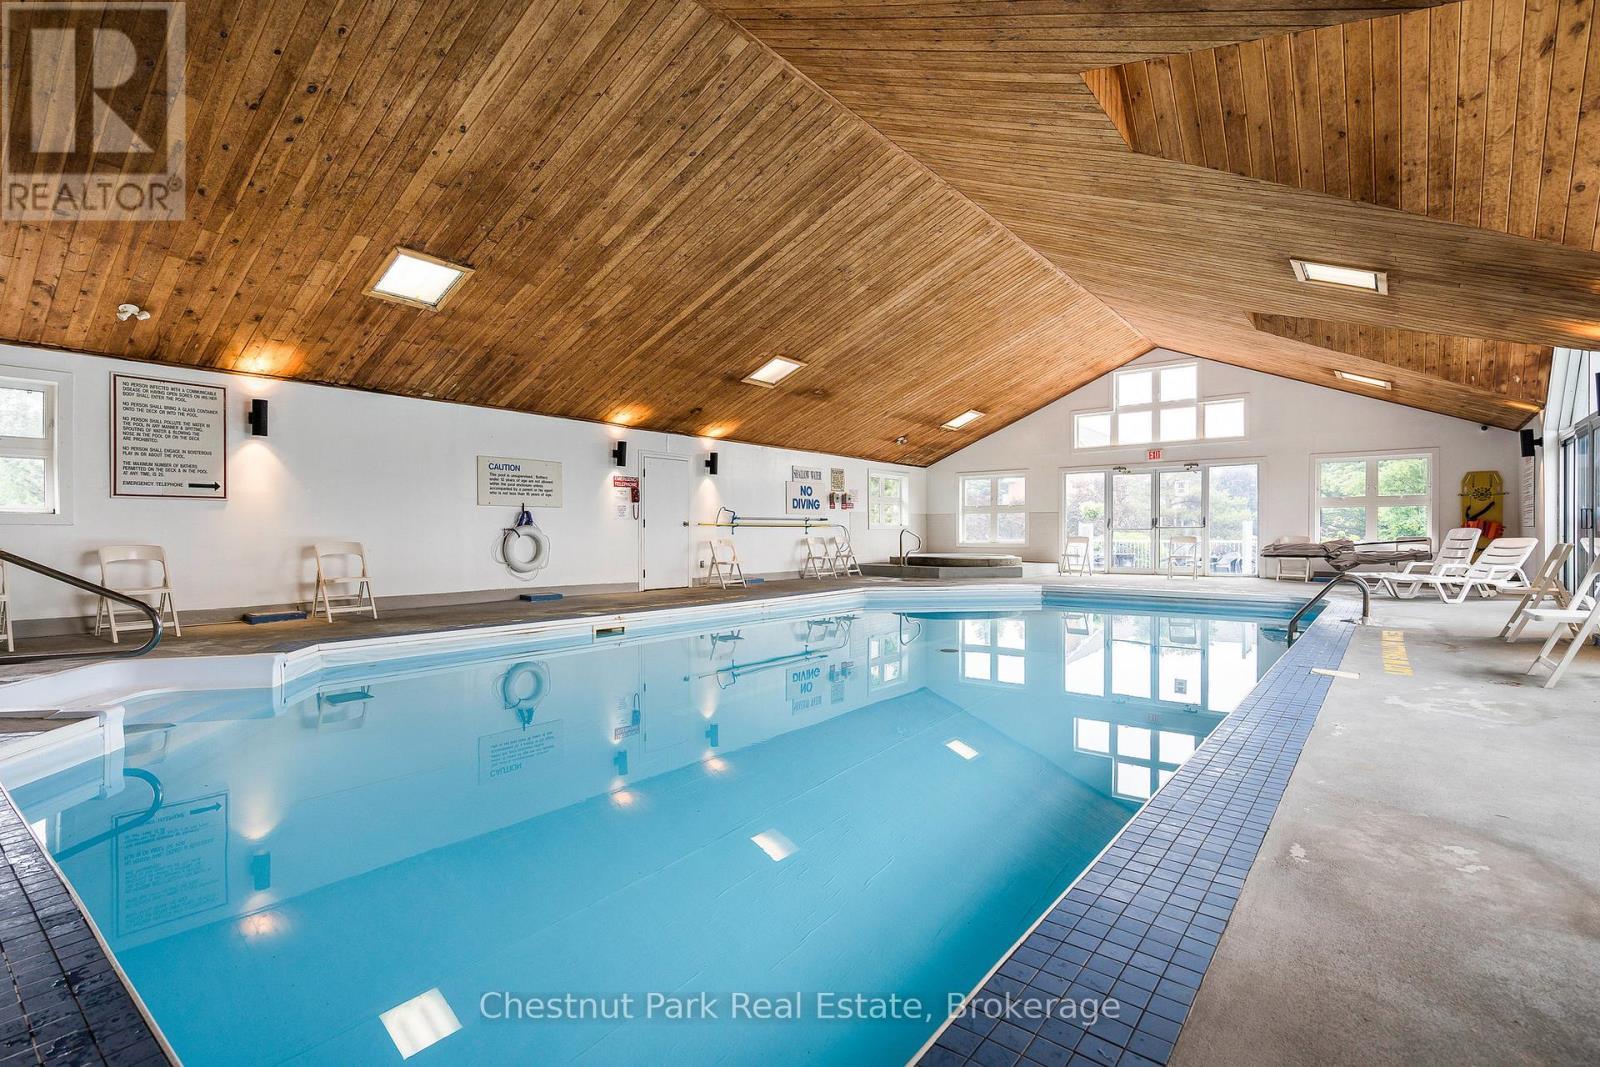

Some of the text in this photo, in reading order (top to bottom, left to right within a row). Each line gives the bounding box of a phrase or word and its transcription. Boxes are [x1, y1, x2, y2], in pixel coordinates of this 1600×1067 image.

[1148, 450, 1160, 460] EXIT
[489, 463, 520, 471] CAUTION
[800, 486, 812, 496] NO
[792, 498, 820, 510] DIVING
